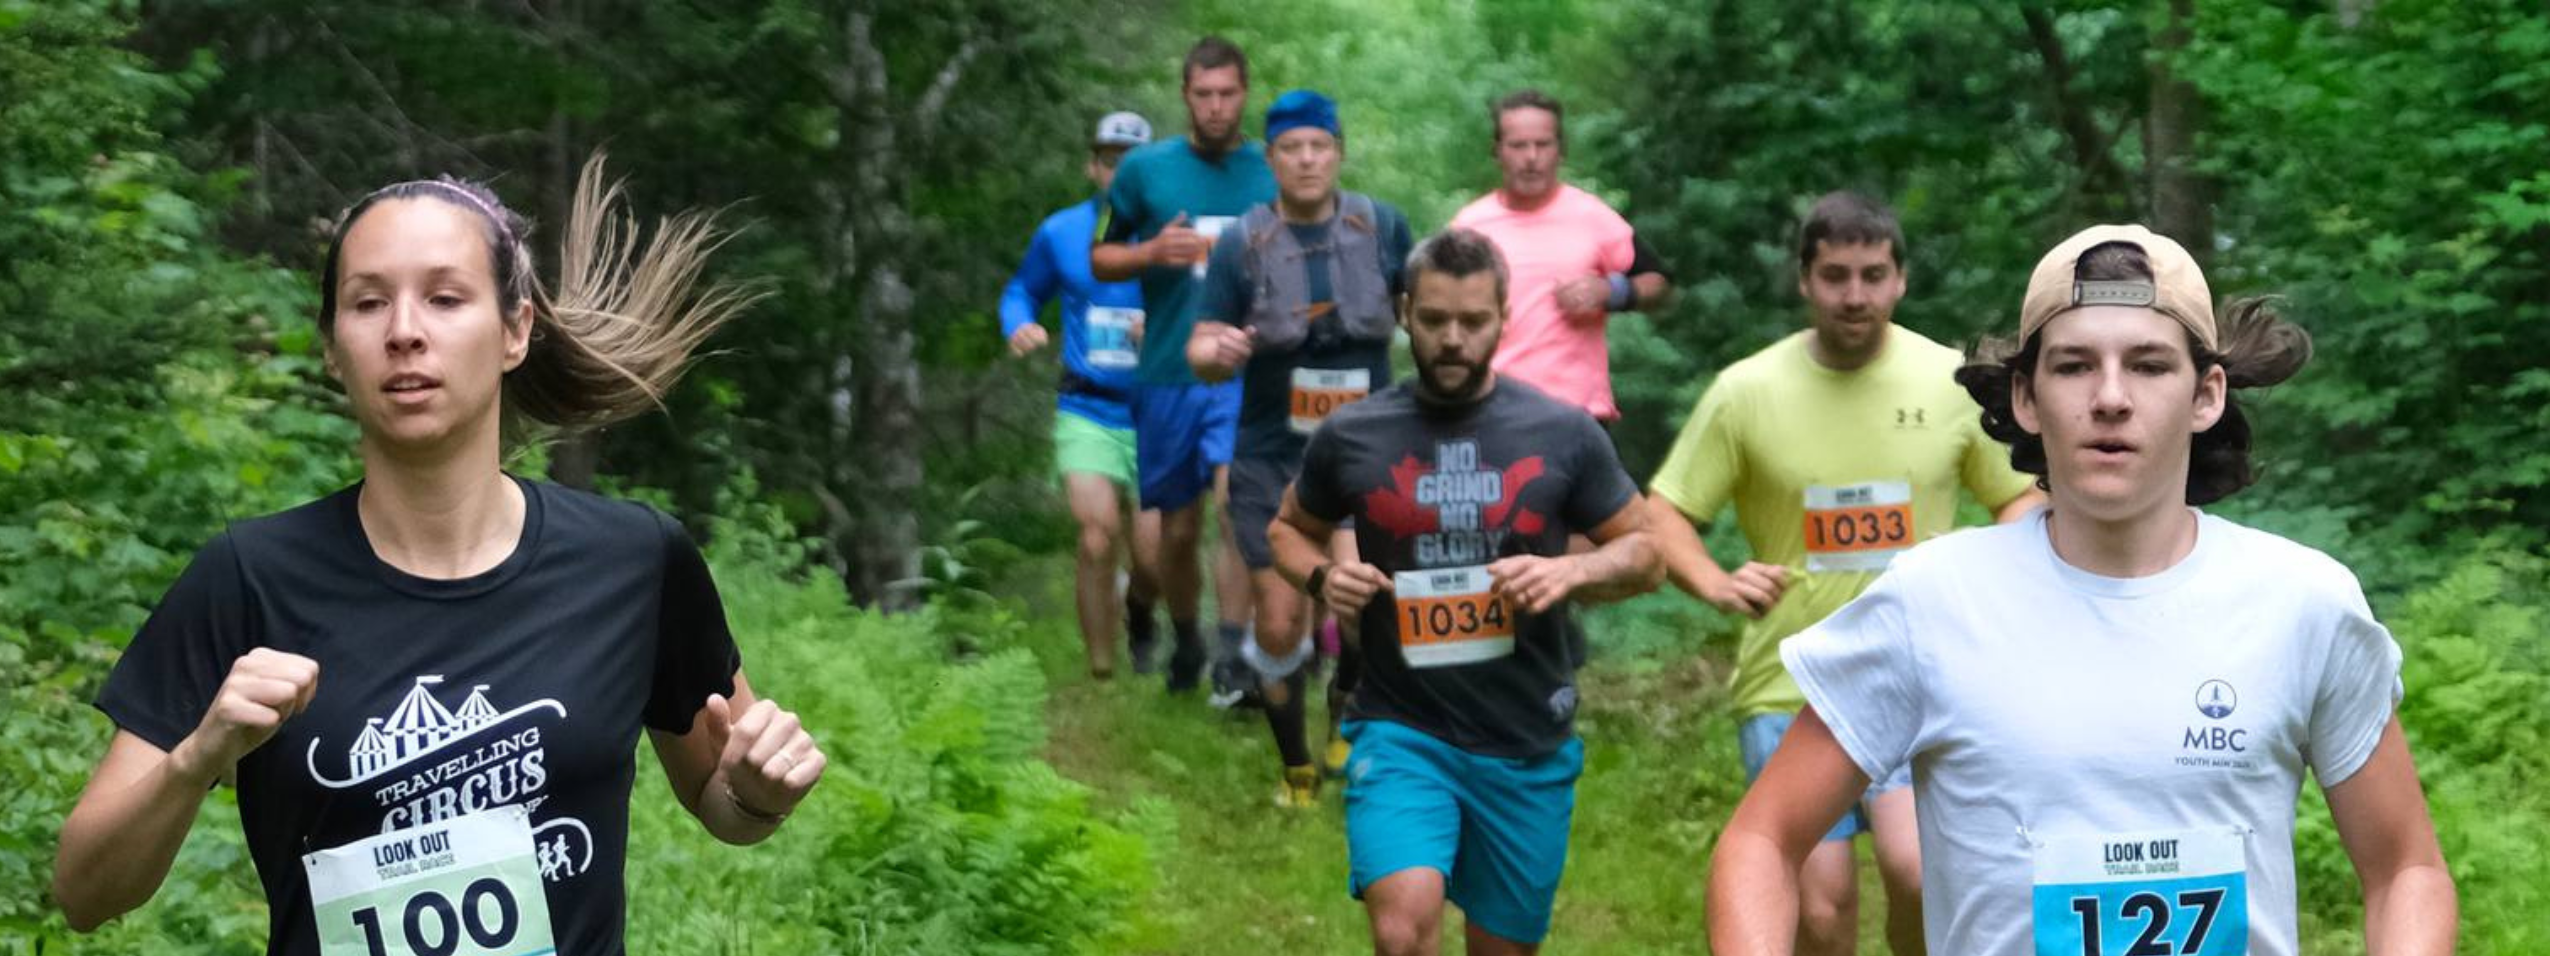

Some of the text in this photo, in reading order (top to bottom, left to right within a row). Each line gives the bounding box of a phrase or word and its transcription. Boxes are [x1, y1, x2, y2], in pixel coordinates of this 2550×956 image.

[1438, 442, 1476, 471] NO
[1416, 471, 1502, 504] GRIND
[1439, 503, 1478, 530] NO
[1812, 510, 1906, 546] 1033
[1416, 530, 1506, 565] GLORY
[1408, 600, 1504, 637] 1034
[2183, 726, 2247, 752] MBC
[376, 727, 541, 806] TRAVELLING
[2175, 756, 2210, 768] YOUTH
[380, 747, 547, 835] CIRCUS
[373, 829, 451, 868] LOOK OUT
[2104, 838, 2179, 863] LOOK OUT
[351, 876, 520, 956] 100
[2072, 888, 2226, 956] 127
